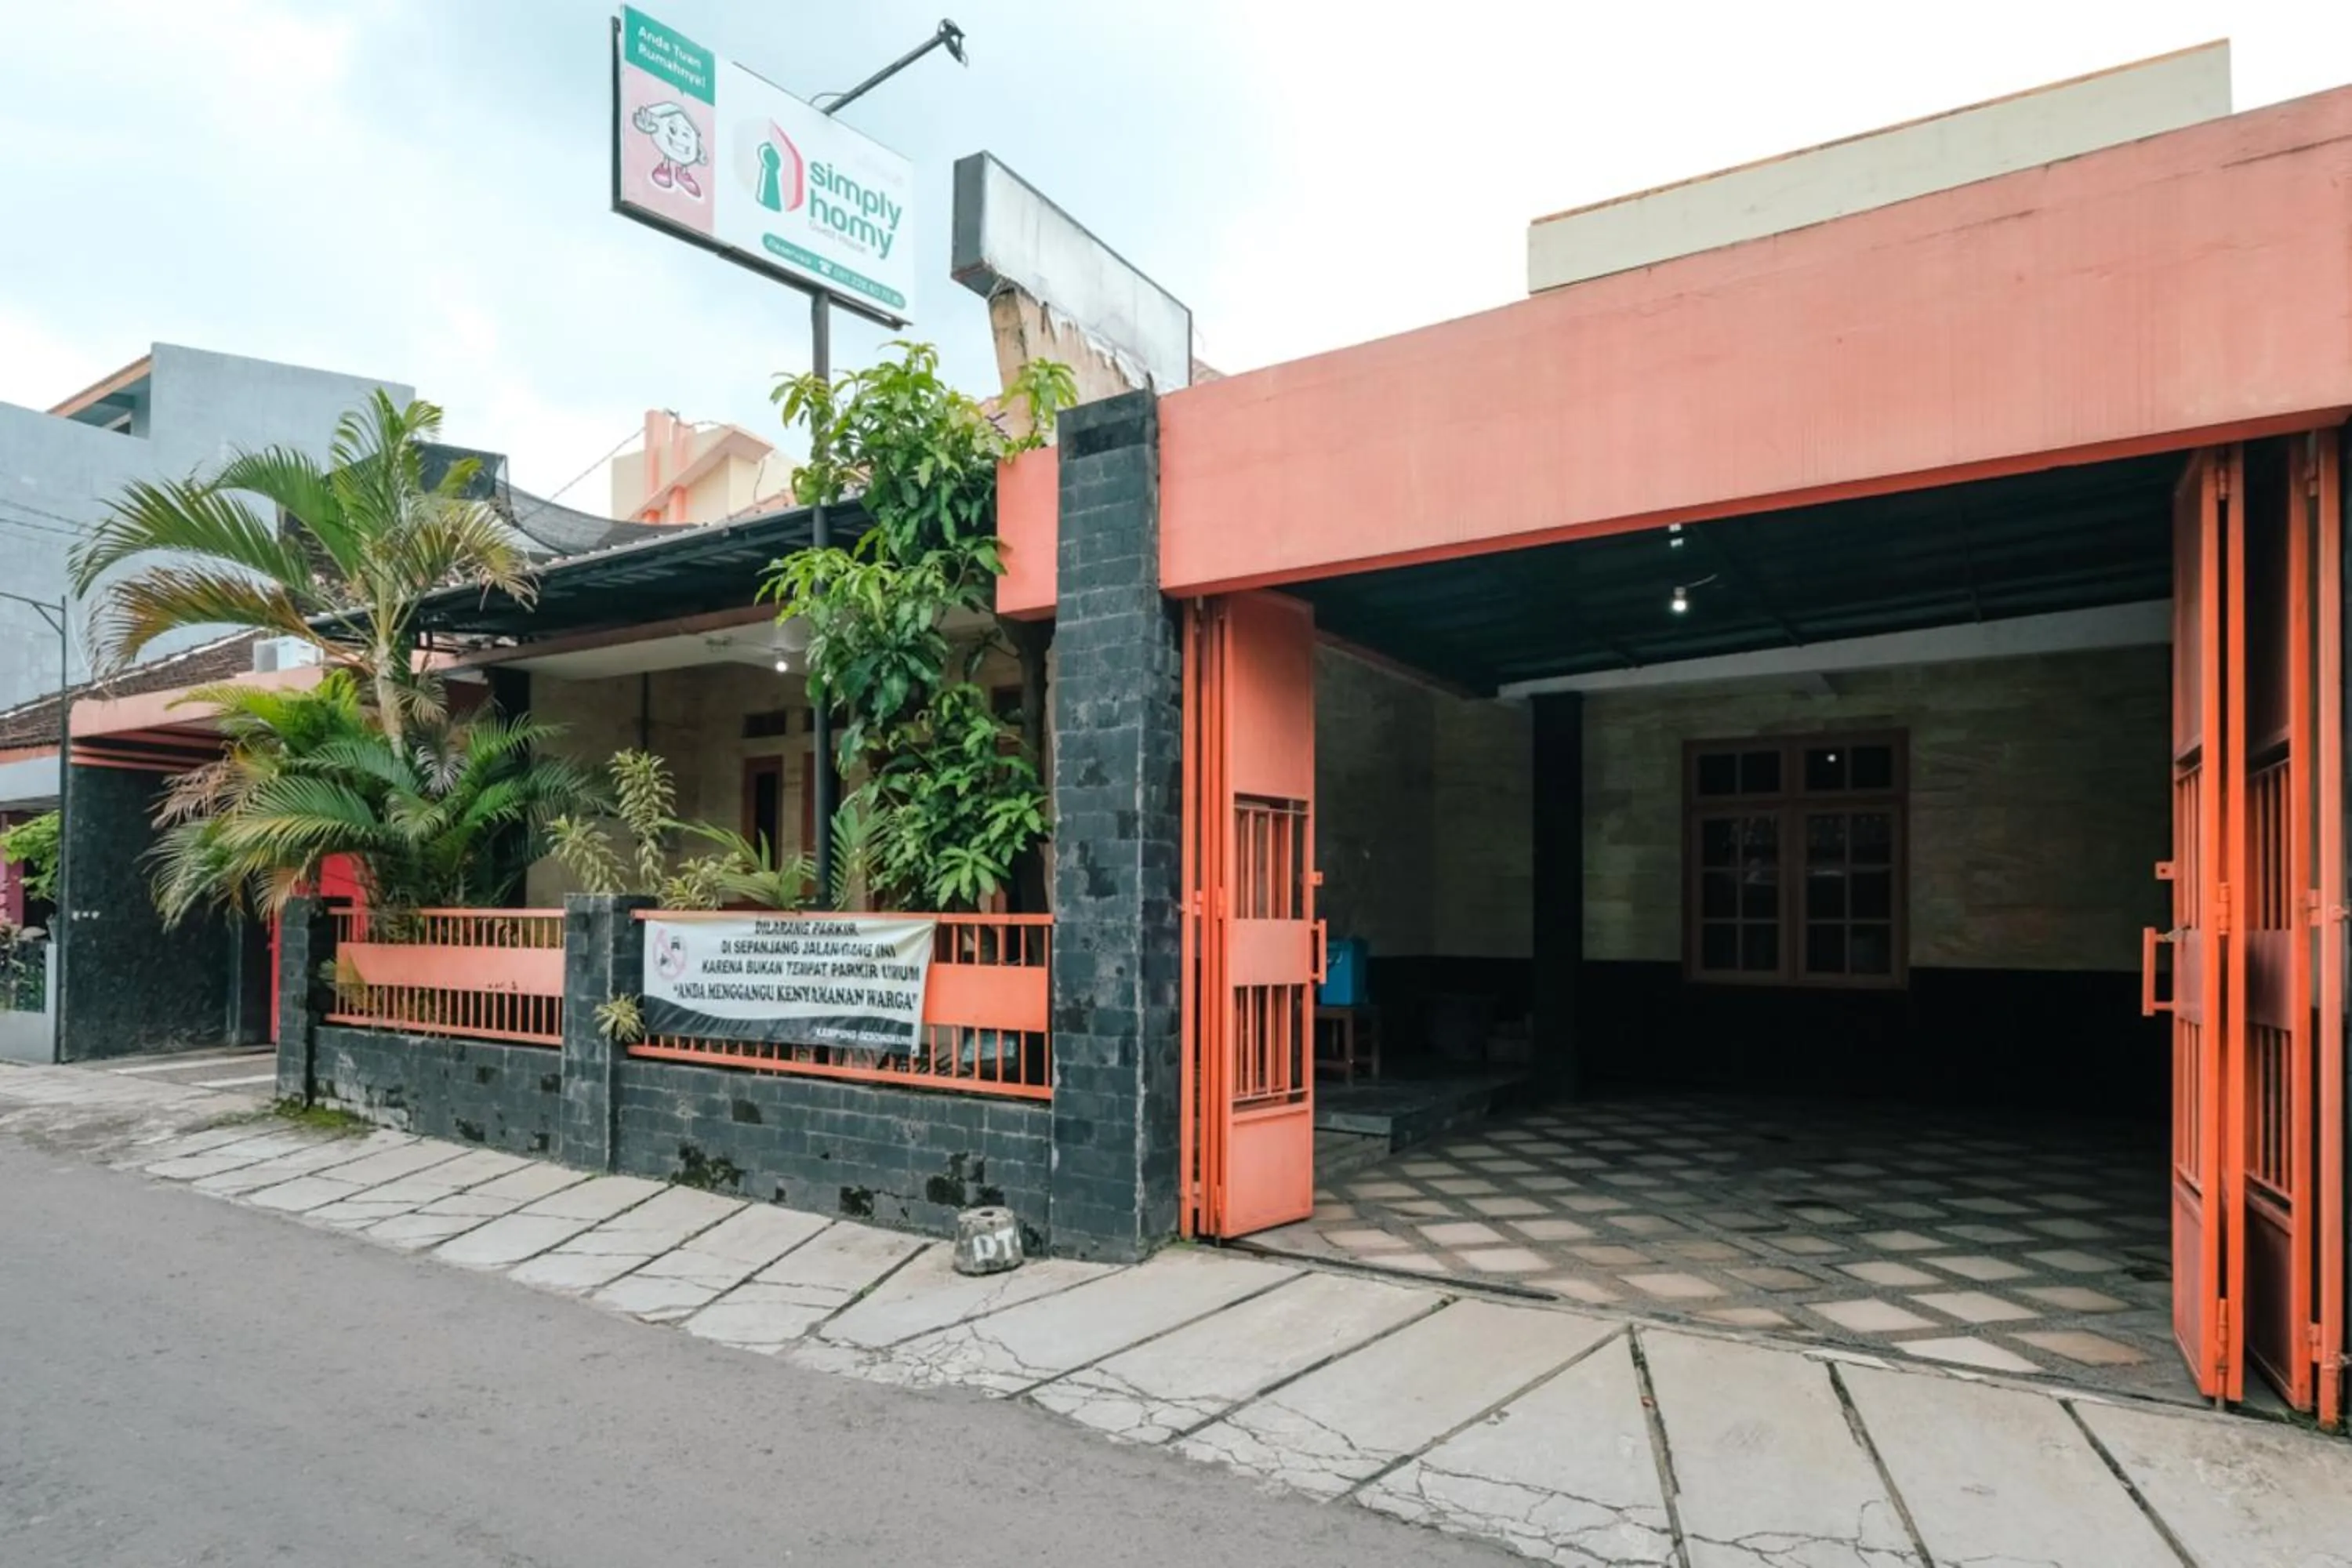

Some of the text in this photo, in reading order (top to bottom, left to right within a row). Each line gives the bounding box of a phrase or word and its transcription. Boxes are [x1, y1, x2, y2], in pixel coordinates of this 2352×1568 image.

[809, 161, 903, 231] simply
[809, 187, 895, 260] homy
[755, 920, 860, 937] DILARANG PARKIR
[721, 940, 732, 954] DI
[734, 940, 799, 955] SEPANJANG
[702, 959, 743, 974] KARENA
[746, 960, 783, 975] BUKAN
[786, 960, 829, 977] TEMPAT
[831, 963, 879, 979] PARKIR
